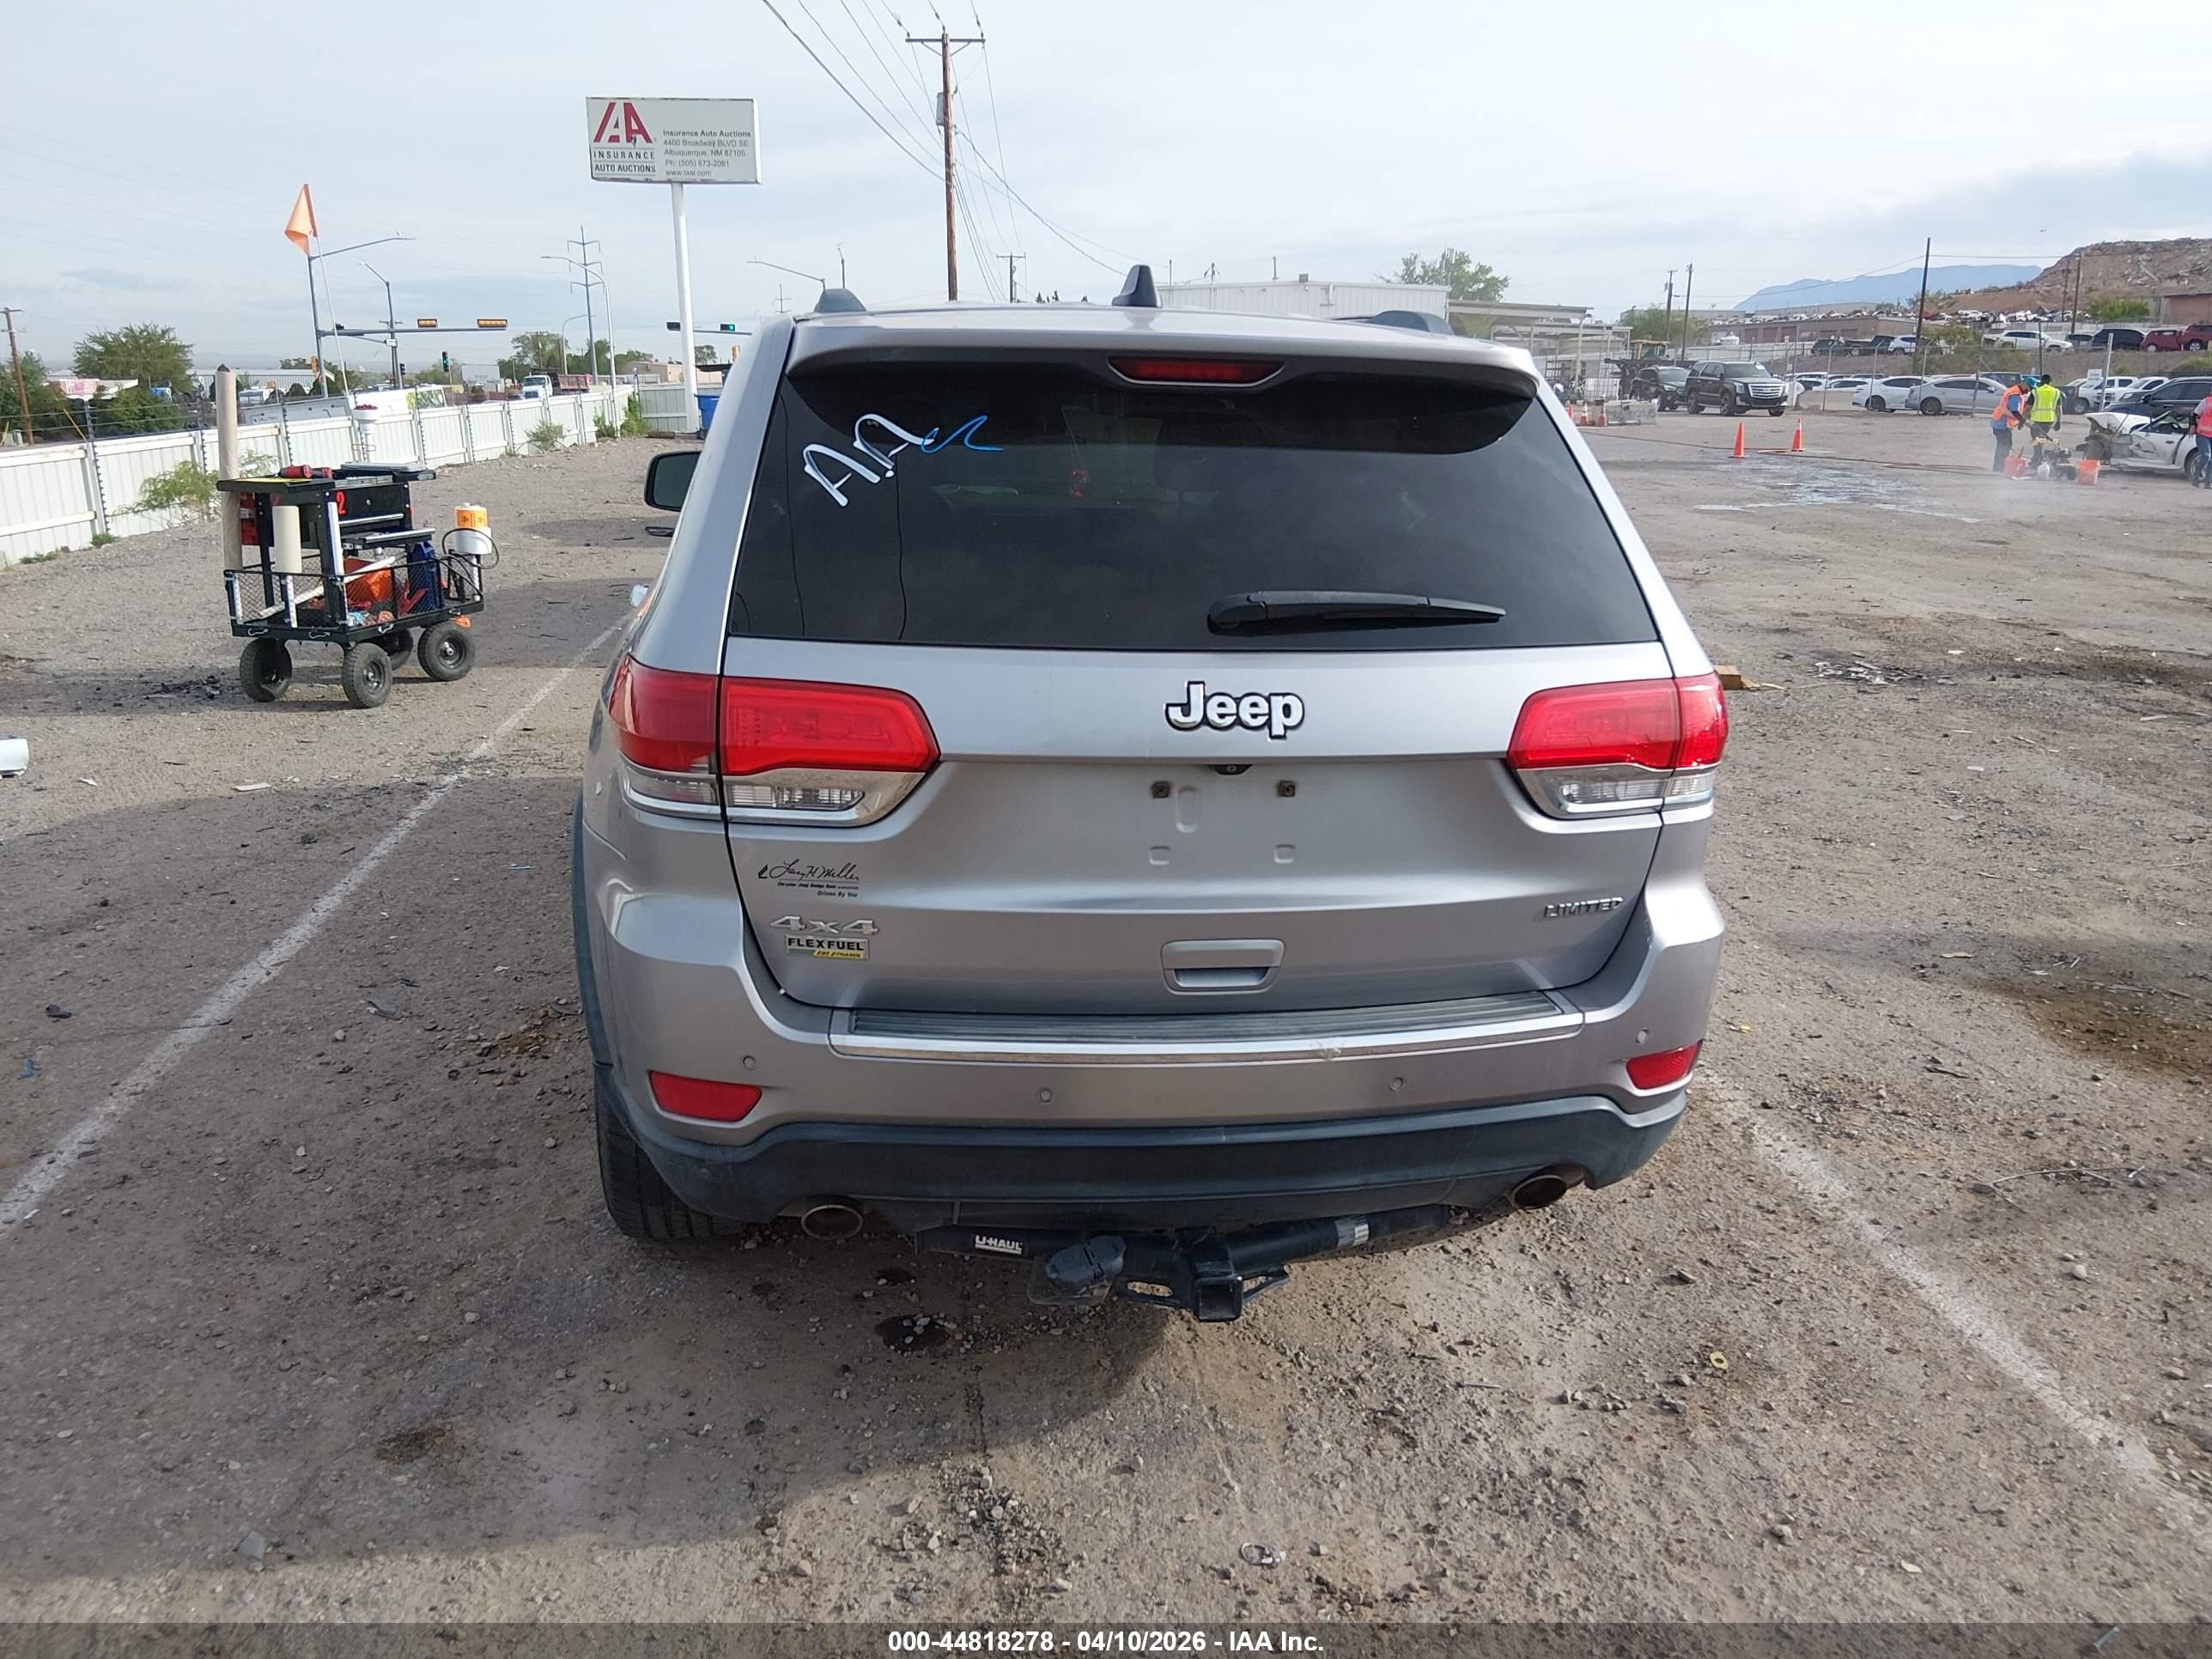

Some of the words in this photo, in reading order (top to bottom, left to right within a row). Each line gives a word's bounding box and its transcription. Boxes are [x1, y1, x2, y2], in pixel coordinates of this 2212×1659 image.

[682, 139, 716, 148] Broadway
[593, 150, 655, 160] INSURANCE
[594, 164, 616, 173] AUTO
[617, 164, 656, 173] AUCTIONS
[336, 490, 346, 514] 2
[1164, 680, 1305, 741] Jeep
[1543, 896, 1625, 918] LIMITED
[975, 1235, 1023, 1252] U-HAUL
